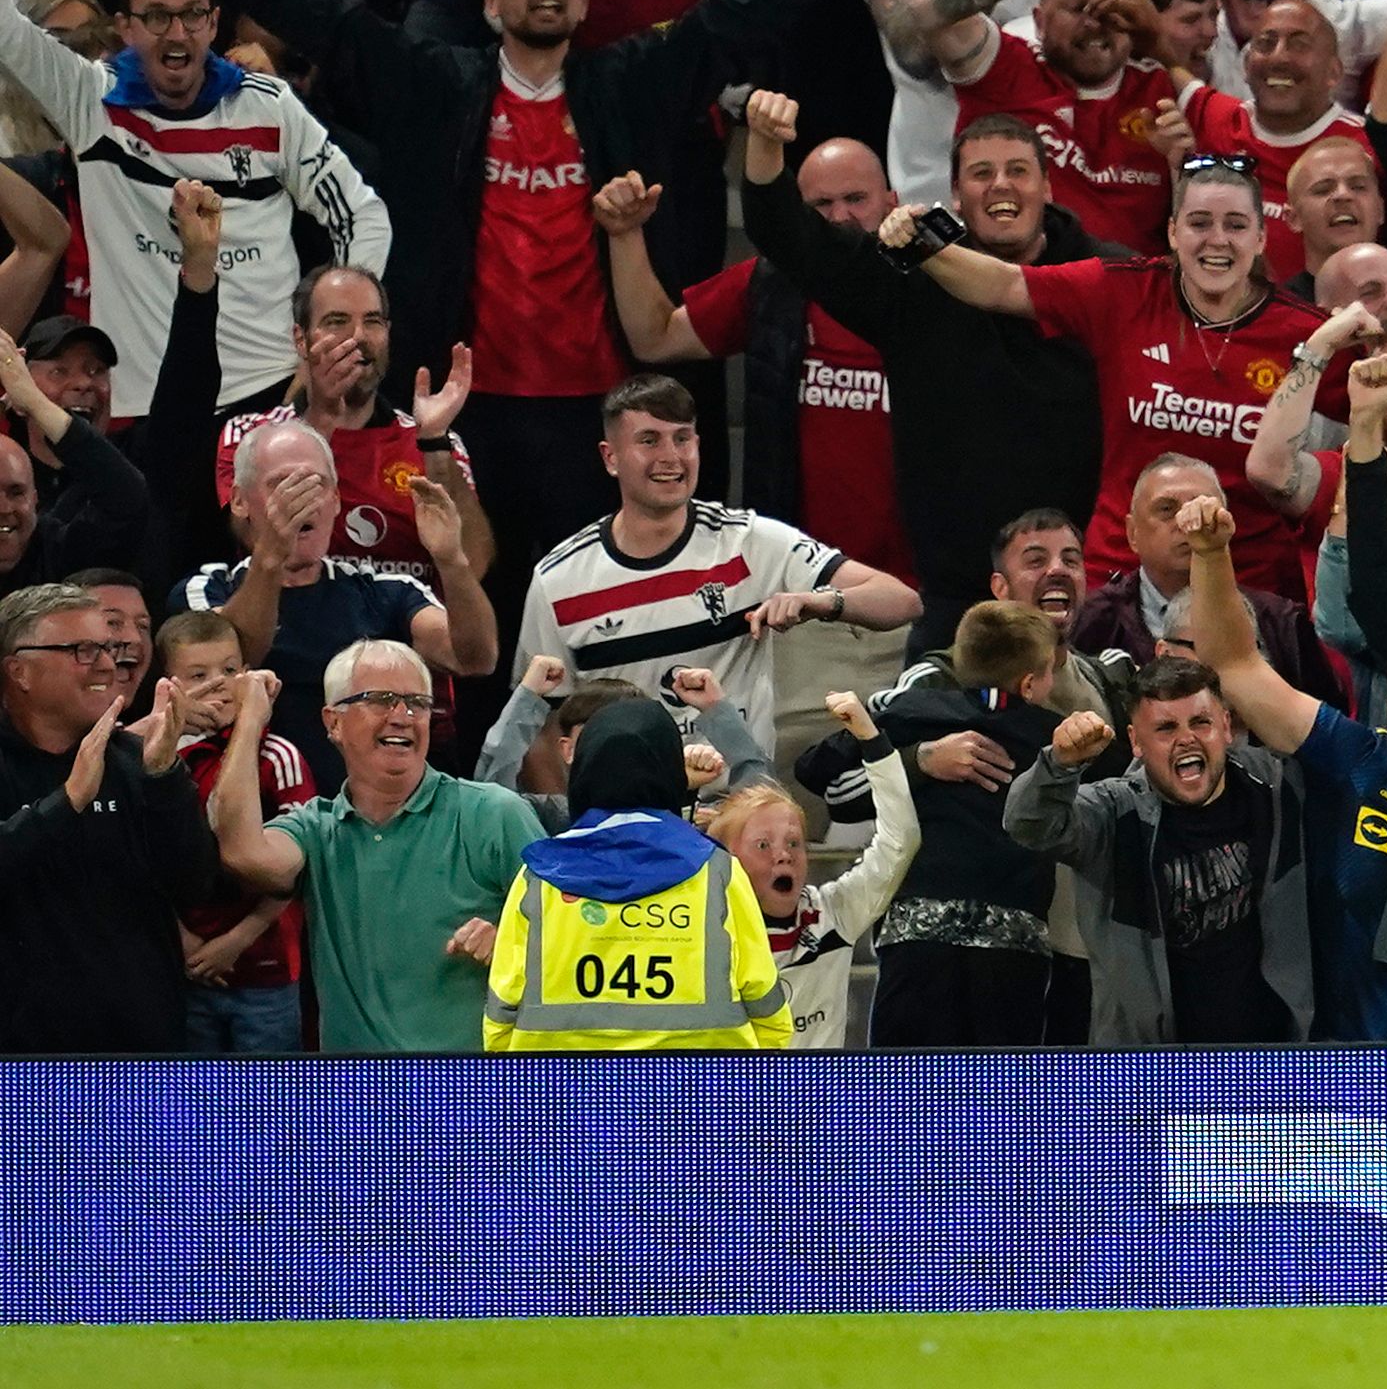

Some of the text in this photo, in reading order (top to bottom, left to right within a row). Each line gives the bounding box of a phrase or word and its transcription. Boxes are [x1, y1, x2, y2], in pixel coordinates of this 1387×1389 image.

[484, 160, 587, 193] SHAR
[802, 359, 883, 394] Team
[798, 379, 882, 413] iewer
[1151, 381, 1234, 420] Team
[1128, 395, 1232, 440] Viewer
[620, 903, 691, 929] CSG
[574, 953, 676, 1000] 045
